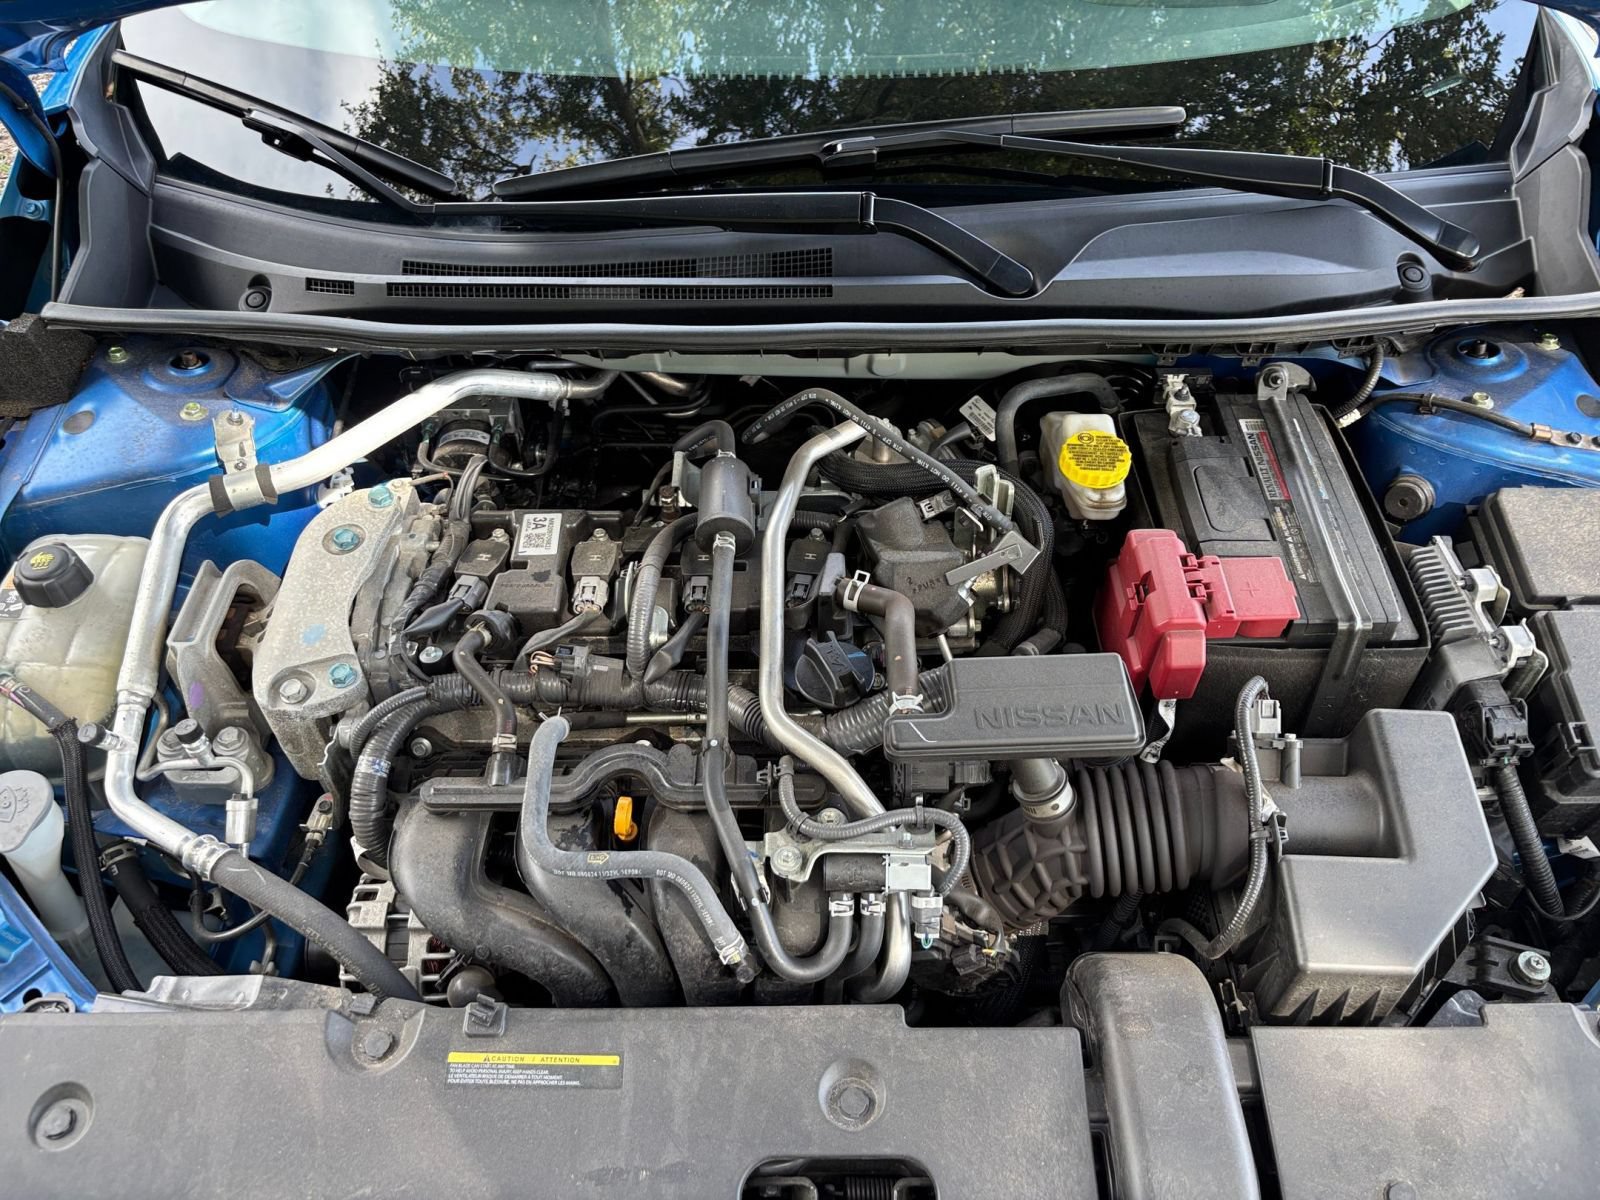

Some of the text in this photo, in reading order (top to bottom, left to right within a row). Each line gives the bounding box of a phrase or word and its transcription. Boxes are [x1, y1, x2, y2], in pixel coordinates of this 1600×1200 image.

[1246, 431, 1264, 466] NISSAN
[1260, 465, 1278, 498] RENAULT
[532, 517, 547, 530] 3A
[974, 702, 1125, 730] NISSAN
